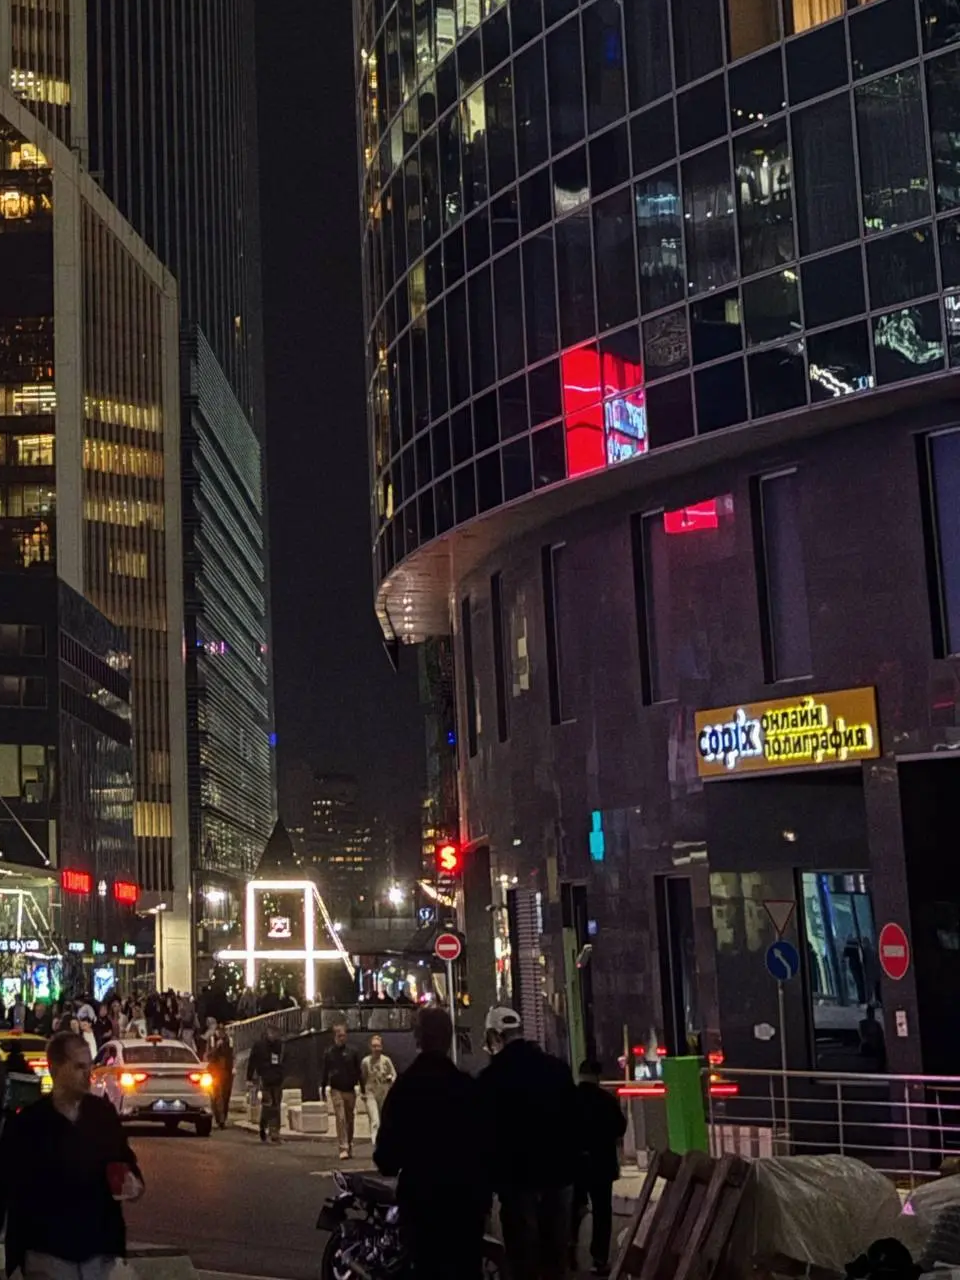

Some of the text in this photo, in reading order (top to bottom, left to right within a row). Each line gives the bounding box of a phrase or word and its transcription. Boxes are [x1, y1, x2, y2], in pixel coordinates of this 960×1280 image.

[761, 696, 828, 734] онлайн
[698, 708, 763, 769] copix
[763, 718, 872, 763] полиграфия
